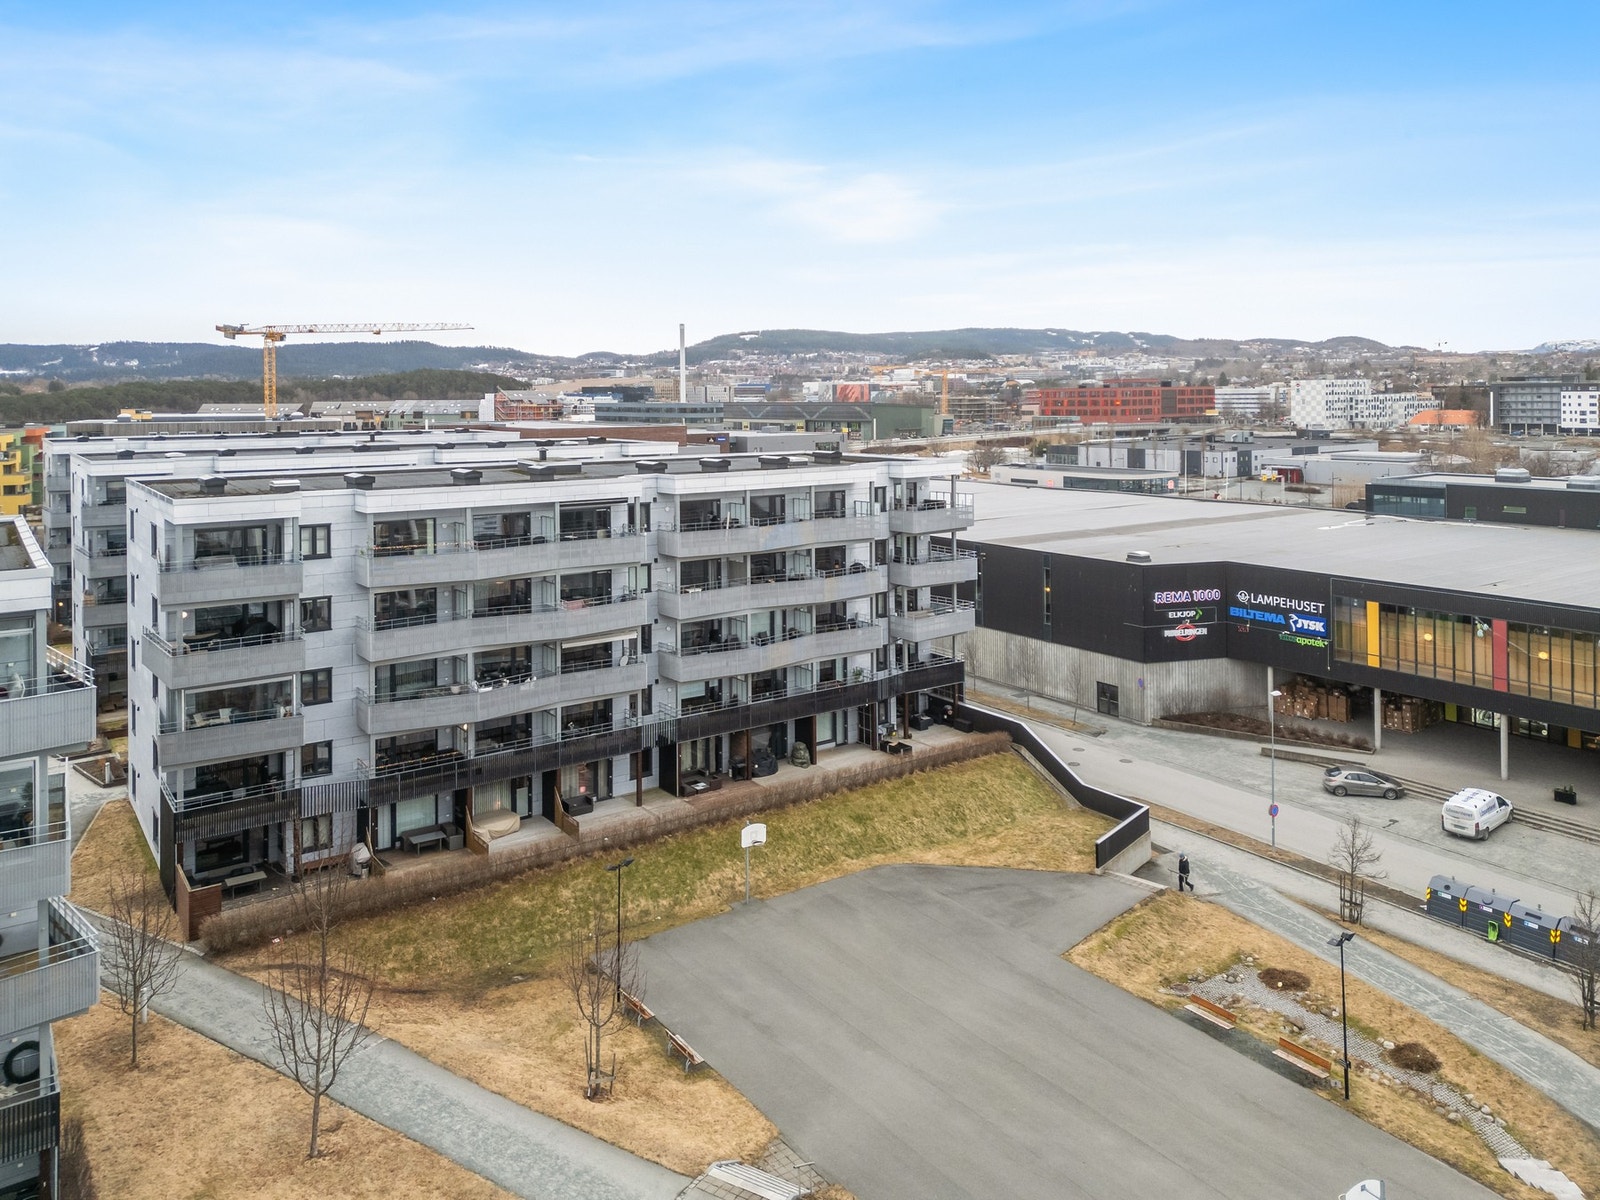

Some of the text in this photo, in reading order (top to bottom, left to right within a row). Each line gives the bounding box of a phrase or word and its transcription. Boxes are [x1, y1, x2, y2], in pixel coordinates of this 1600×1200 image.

[1155, 589, 1221, 604] REMA 1000
[1251, 593, 1325, 614] LAMPEHUSET
[1229, 606, 1286, 625] BILTEMA
[1296, 618, 1325, 632] JYSK
